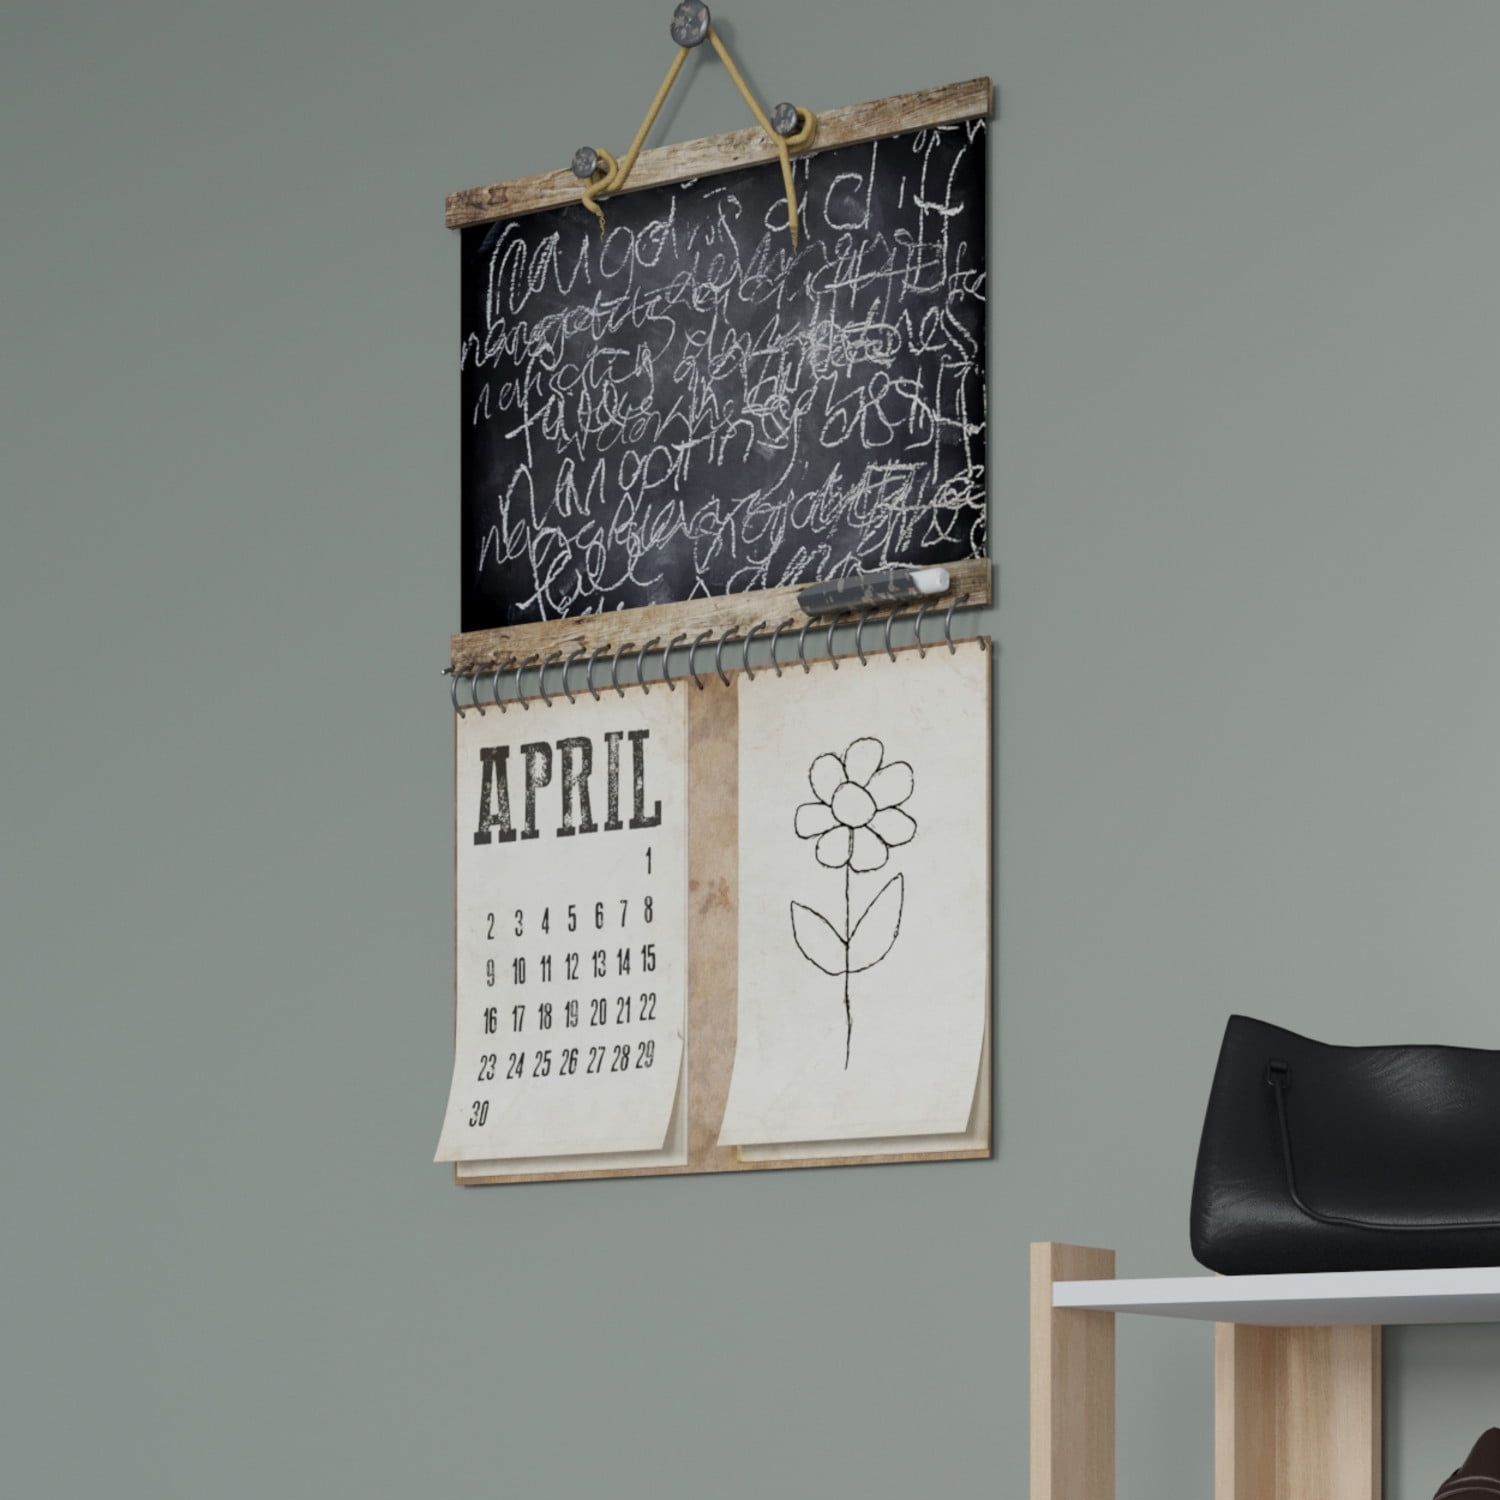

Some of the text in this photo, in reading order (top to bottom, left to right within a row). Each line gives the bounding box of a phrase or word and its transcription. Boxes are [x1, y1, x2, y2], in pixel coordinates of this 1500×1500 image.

[472, 729, 662, 846] APRIL
[645, 847, 652, 874] 1
[487, 896, 653, 940] 2 3 4 5 6 7 8
[486, 944, 656, 986] 9 10 11 12 13 14 15
[483, 993, 657, 1034] 16 17 18 19 20 21 22
[477, 1041, 655, 1081] 23 24 25 26 27 28 29
[468, 1101, 490, 1127] 30
